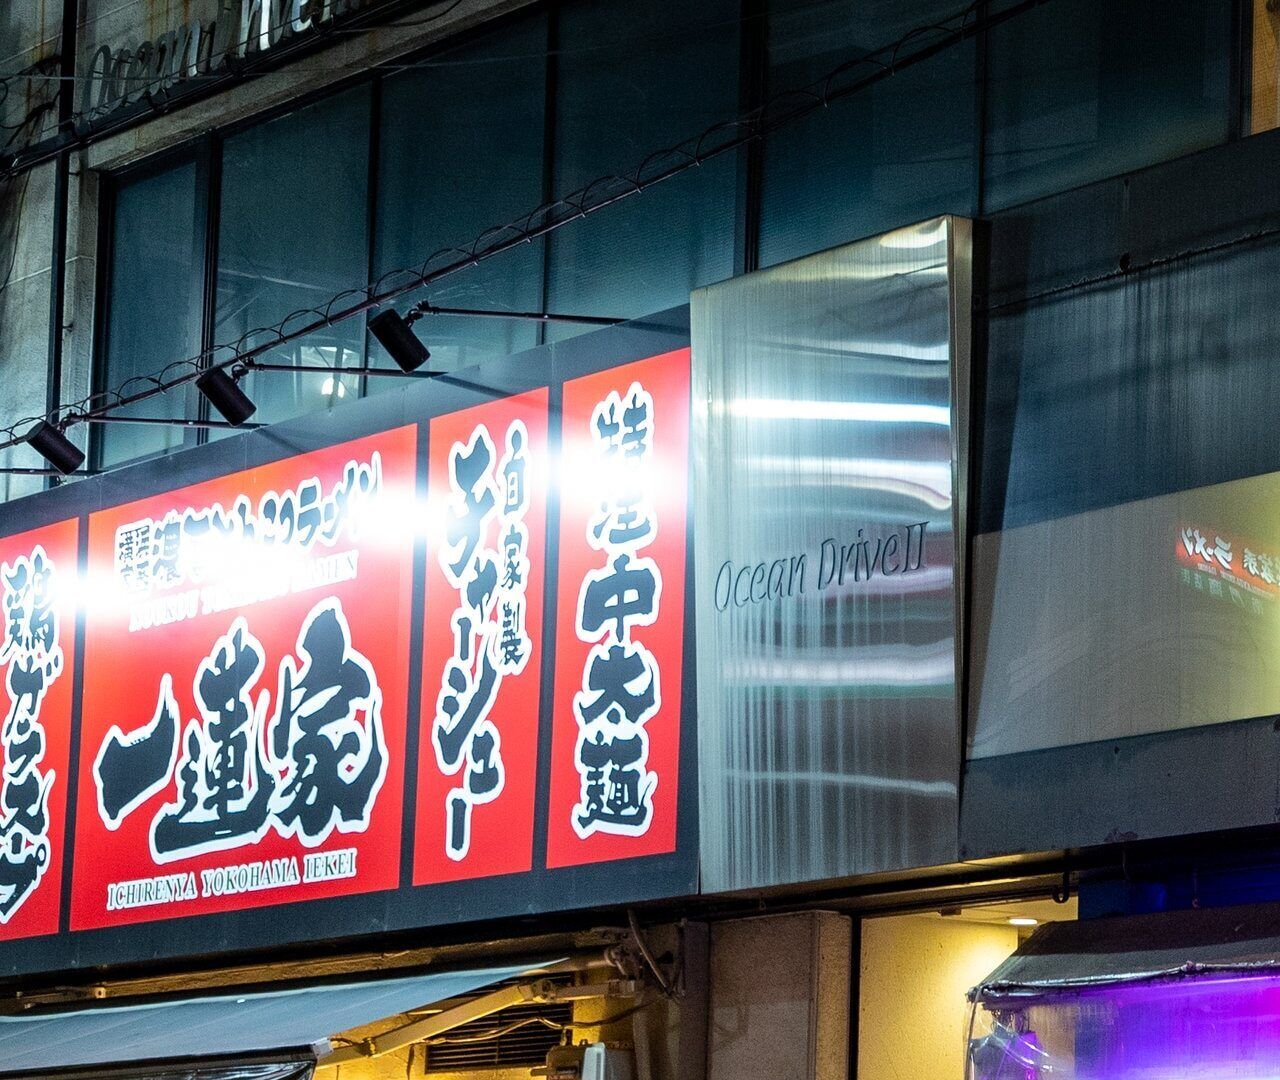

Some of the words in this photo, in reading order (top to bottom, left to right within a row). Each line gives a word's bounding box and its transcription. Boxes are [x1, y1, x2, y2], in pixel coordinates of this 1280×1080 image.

[714, 556, 806, 613] Ocean
[106, 872, 198, 911] ICHIRENYA
[200, 859, 299, 900] YOKOHAMA
[303, 846, 358, 881] IEKEI
